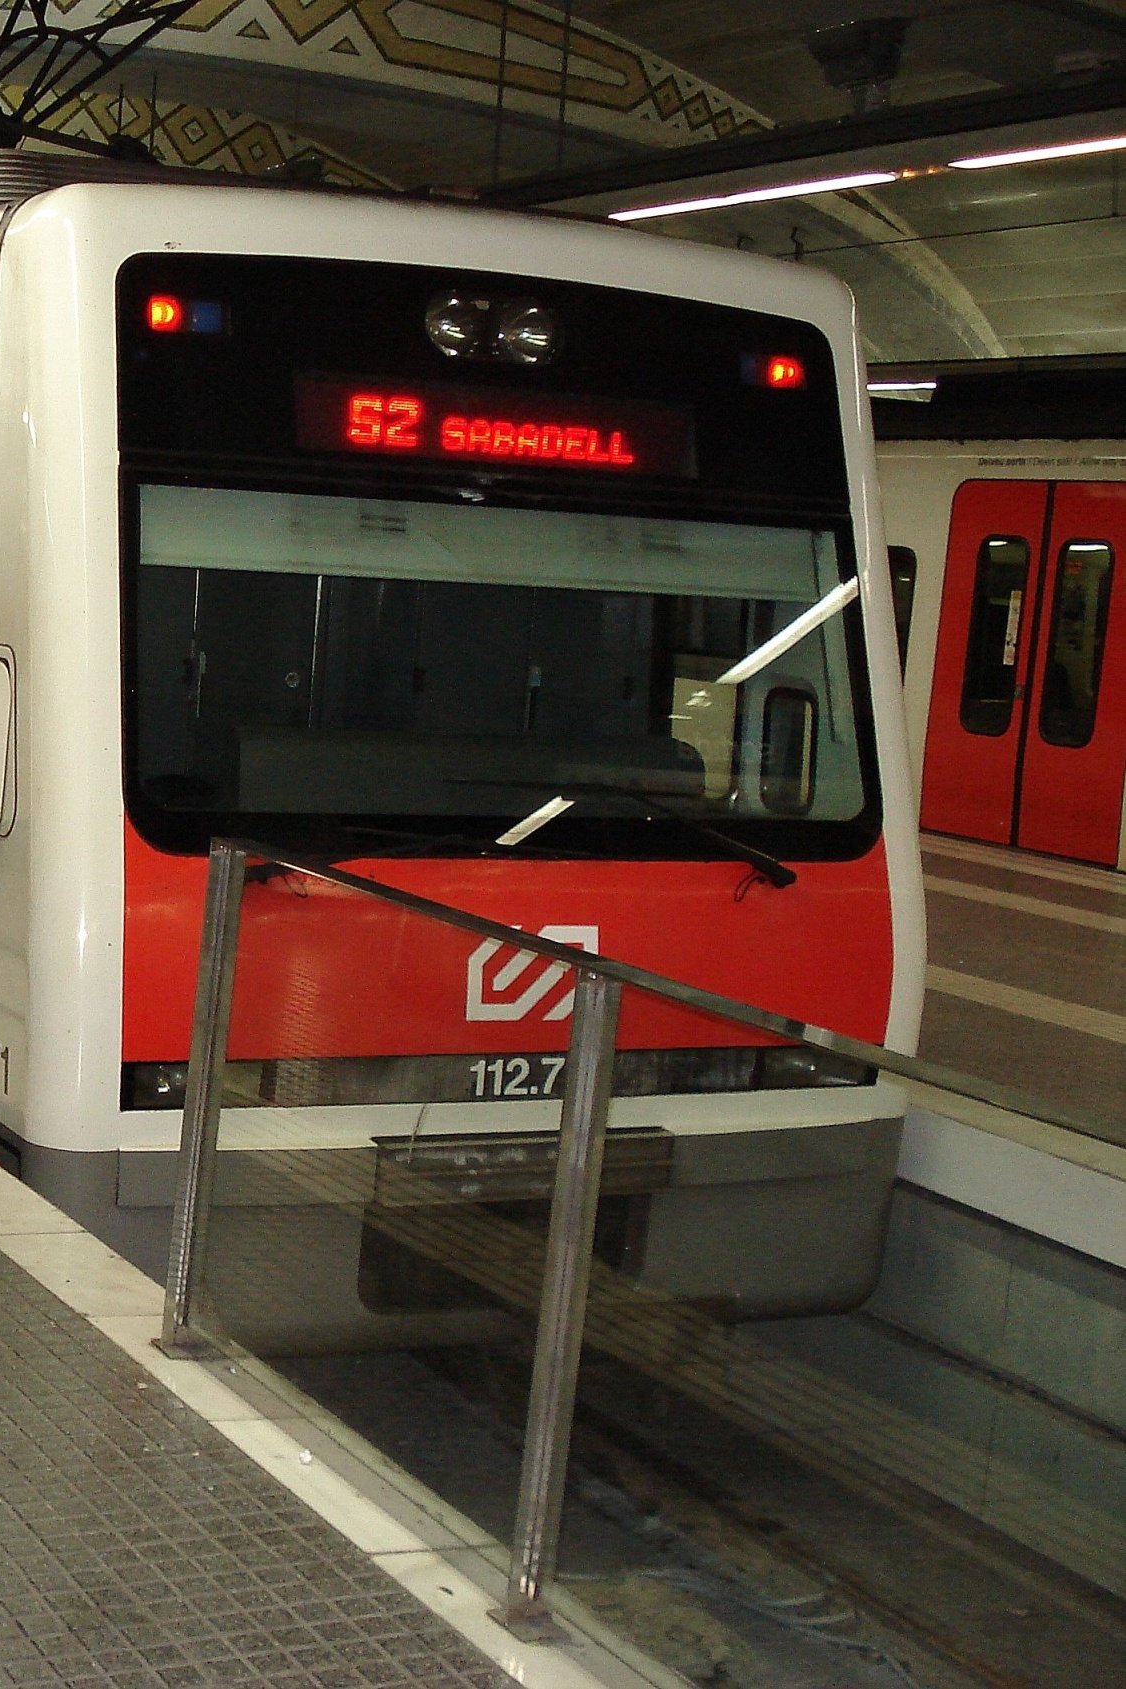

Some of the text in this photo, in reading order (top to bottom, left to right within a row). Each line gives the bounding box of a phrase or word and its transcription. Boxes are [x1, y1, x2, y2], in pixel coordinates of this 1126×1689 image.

[348, 394, 634, 464] S2 SABADELL
[470, 1057, 566, 1096] 112.7
